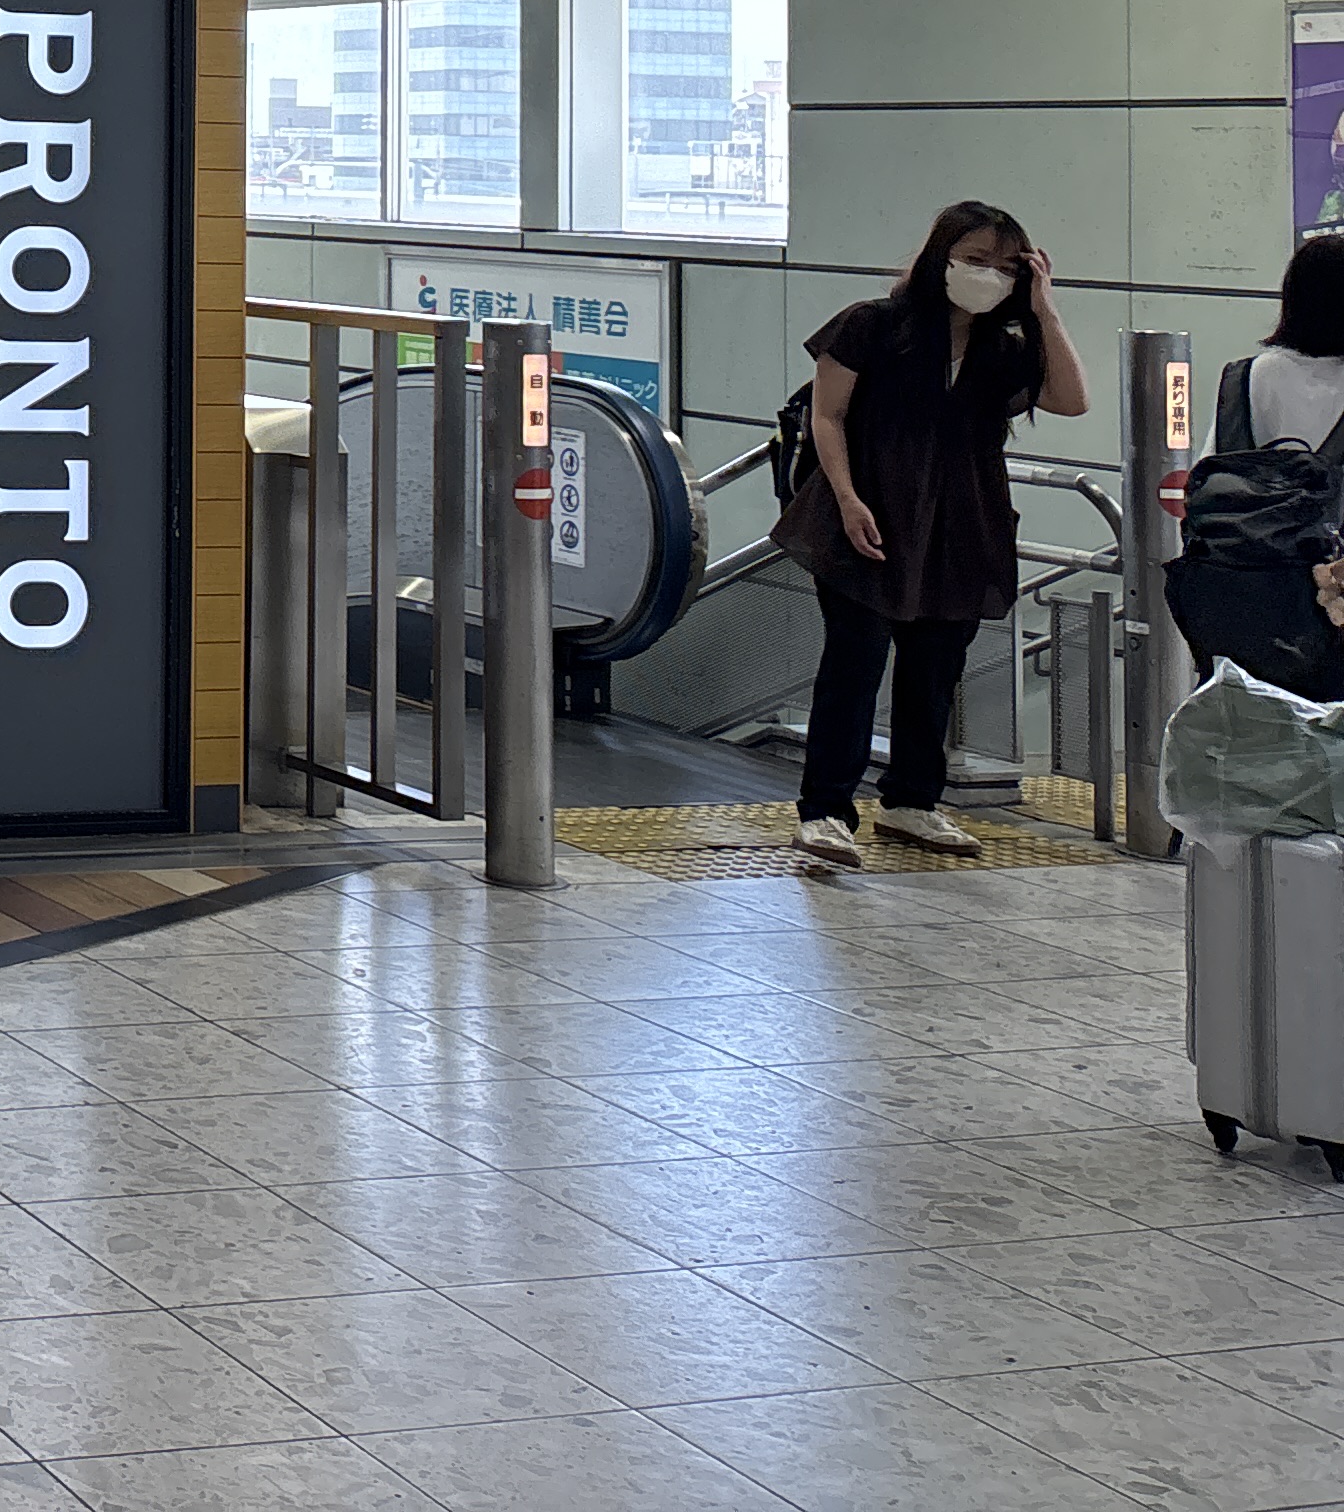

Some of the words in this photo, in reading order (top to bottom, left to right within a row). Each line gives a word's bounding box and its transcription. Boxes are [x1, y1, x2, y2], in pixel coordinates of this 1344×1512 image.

[449, 286, 537, 324] 医療法人
[552, 294, 629, 338] 積善会
[528, 372, 545, 428] 自動
[1171, 375, 1186, 436] 昇り専用
